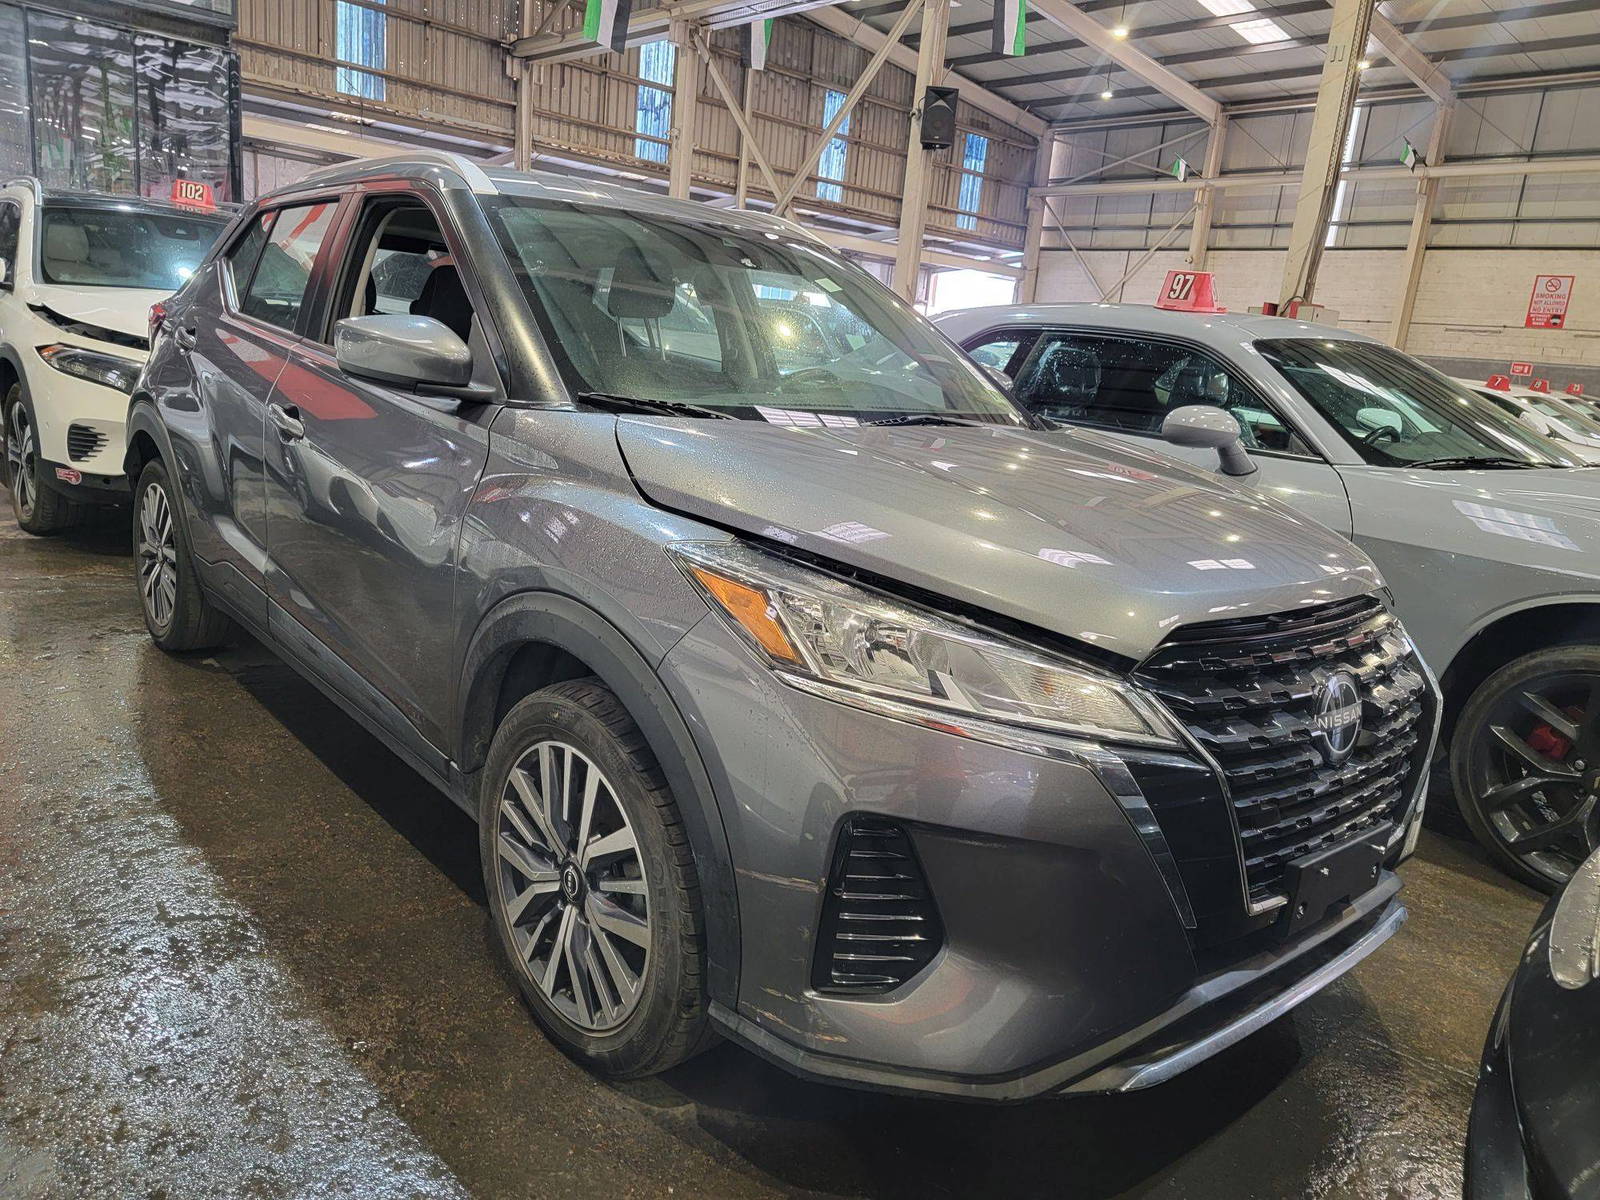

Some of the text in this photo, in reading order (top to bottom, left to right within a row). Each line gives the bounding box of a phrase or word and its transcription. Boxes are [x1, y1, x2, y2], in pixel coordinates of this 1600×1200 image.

[181, 182, 204, 201] 102
[1169, 274, 1195, 299] 97
[1316, 704, 1362, 729] NISSAN
